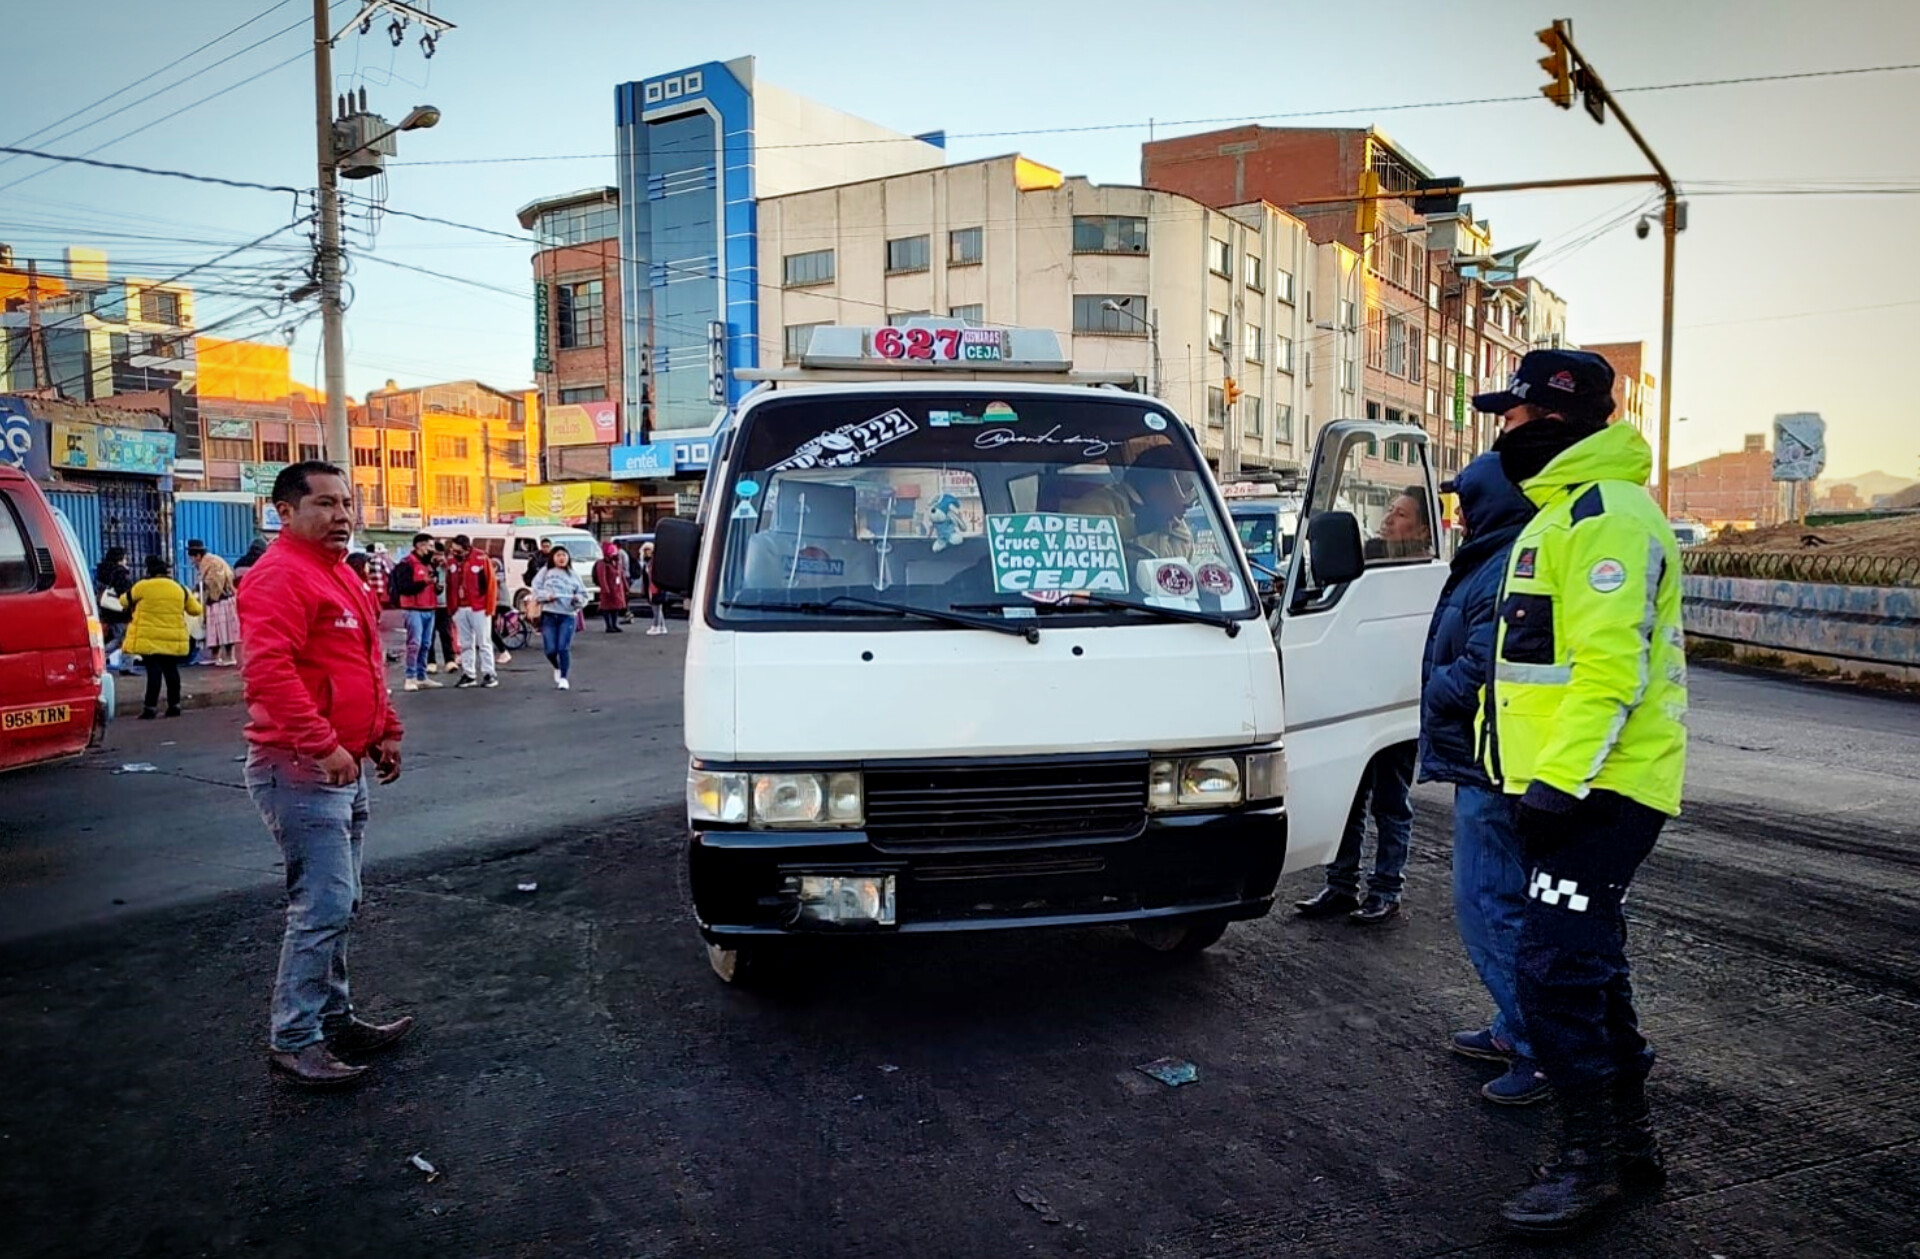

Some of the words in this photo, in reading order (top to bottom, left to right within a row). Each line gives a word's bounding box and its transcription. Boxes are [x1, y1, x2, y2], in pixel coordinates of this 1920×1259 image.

[538, 285, 548, 359] ALOJAMIENTO
[875, 328, 962, 359] 627
[966, 345, 1000, 359] CEJA
[853, 412, 910, 449] 222
[991, 517, 1014, 533] V.
[1024, 516, 1114, 534] ADELA
[995, 535, 1040, 550] Cruce
[1044, 533, 1060, 549] V.
[1064, 534, 1118, 550] ADELA
[1000, 569, 1125, 590] CEJA
